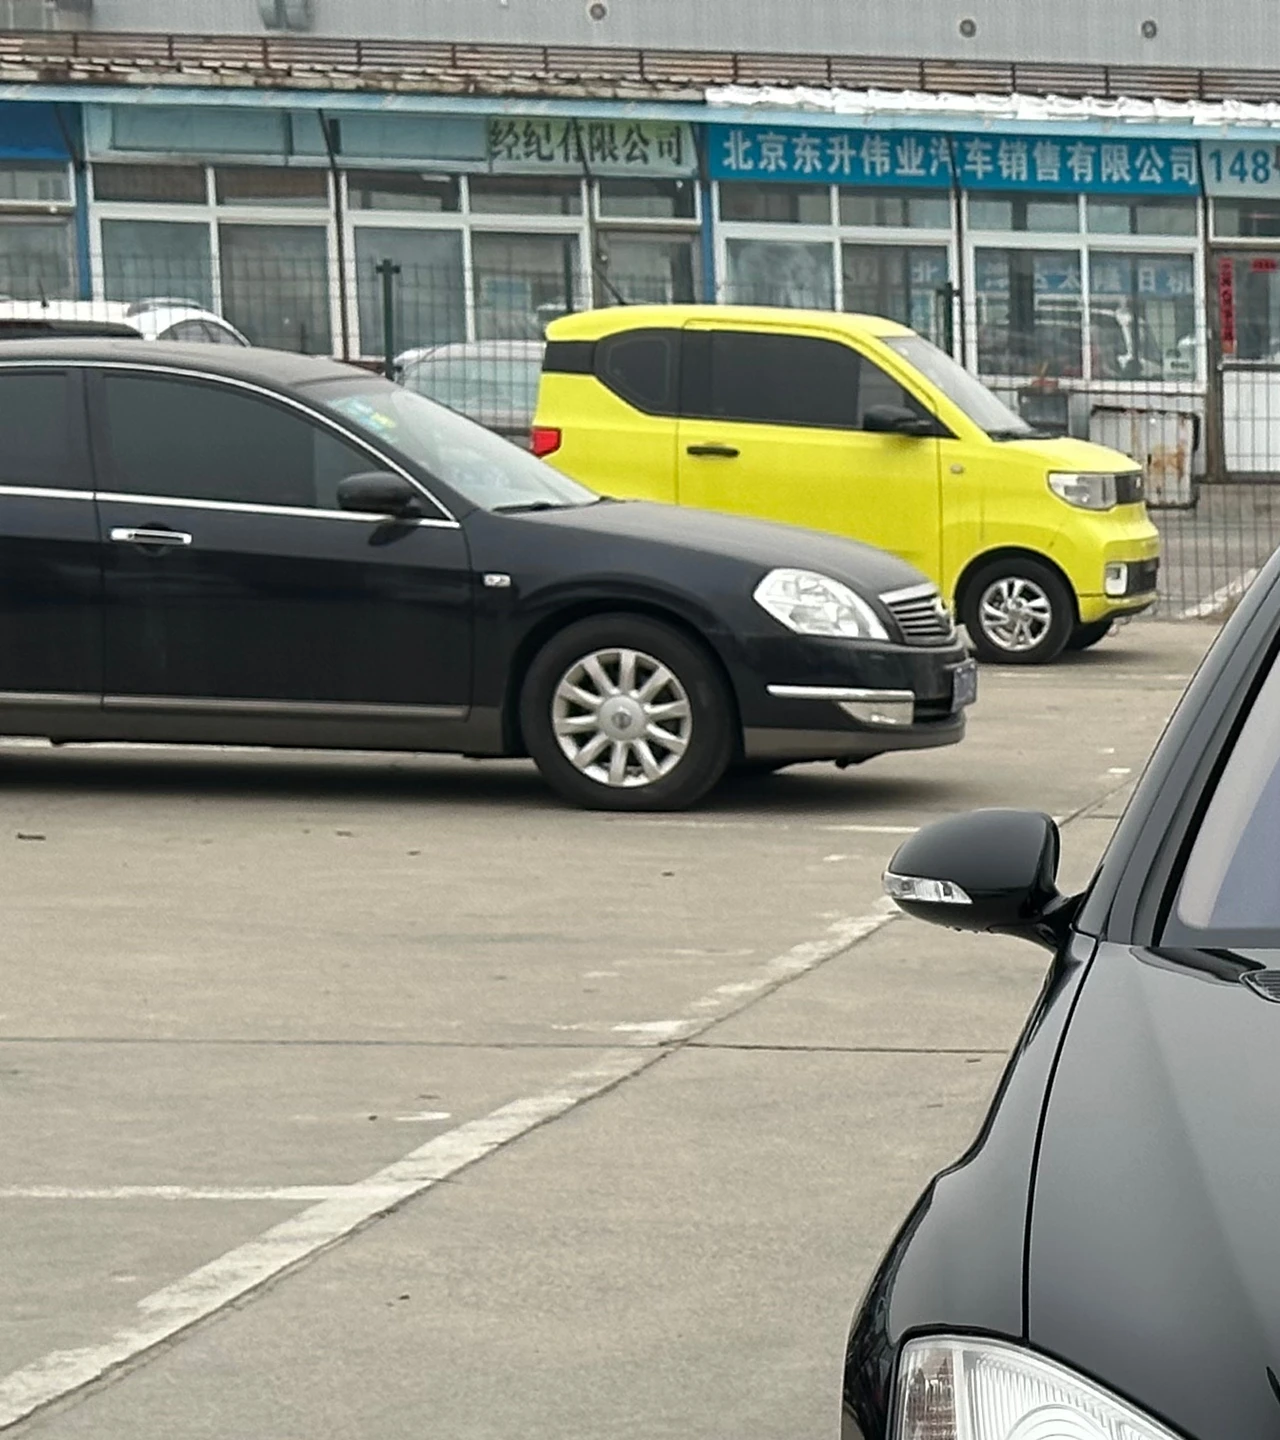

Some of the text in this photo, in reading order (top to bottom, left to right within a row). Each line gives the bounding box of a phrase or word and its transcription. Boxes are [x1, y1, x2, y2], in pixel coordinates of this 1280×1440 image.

[488, 119, 682, 165] 经纪有限公司
[722, 129, 1197, 186] 北京东升伟业汽车销售有限公司
